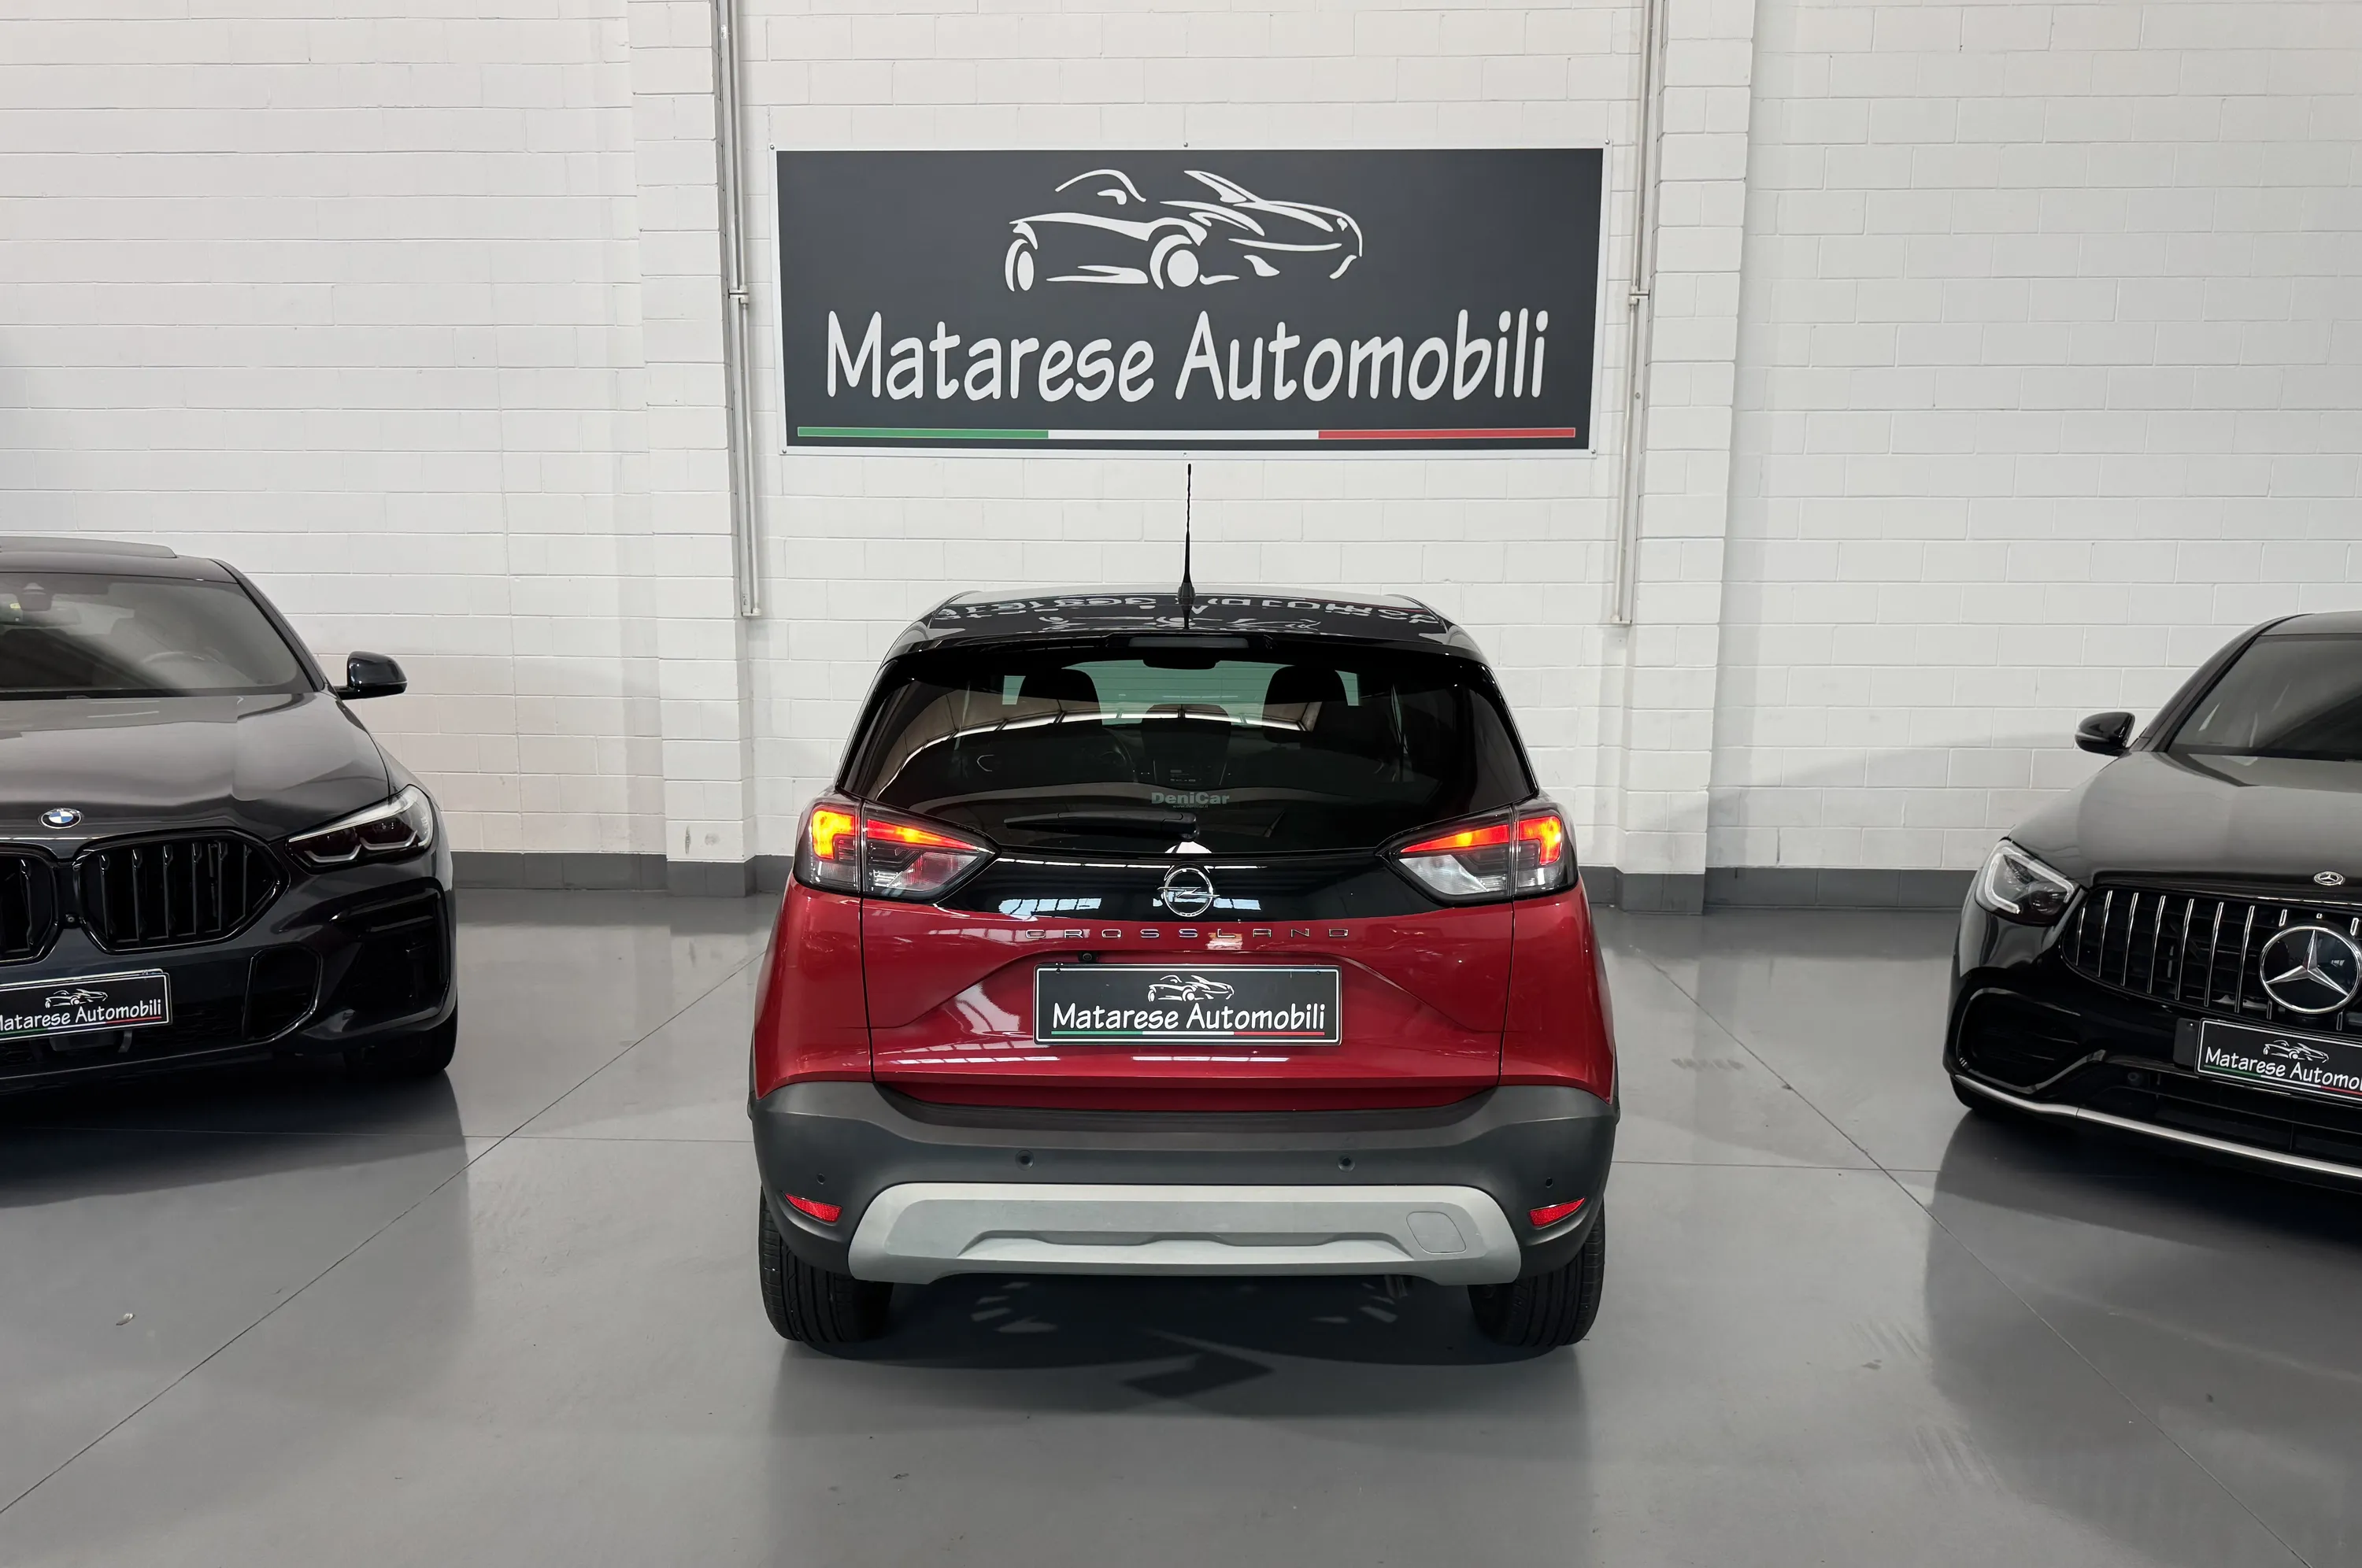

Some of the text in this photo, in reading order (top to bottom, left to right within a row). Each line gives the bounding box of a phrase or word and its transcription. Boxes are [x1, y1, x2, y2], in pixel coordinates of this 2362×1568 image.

[827, 308, 1549, 403] Matarese Automobili
[1151, 791, 1230, 804] DeniCar
[1025, 928, 1349, 939] CROSSLAND
[75, 998, 162, 1023] Automobili
[1052, 1002, 1326, 1030] Matarese Automobili
[2205, 1046, 2362, 1092] Matarese Automo
